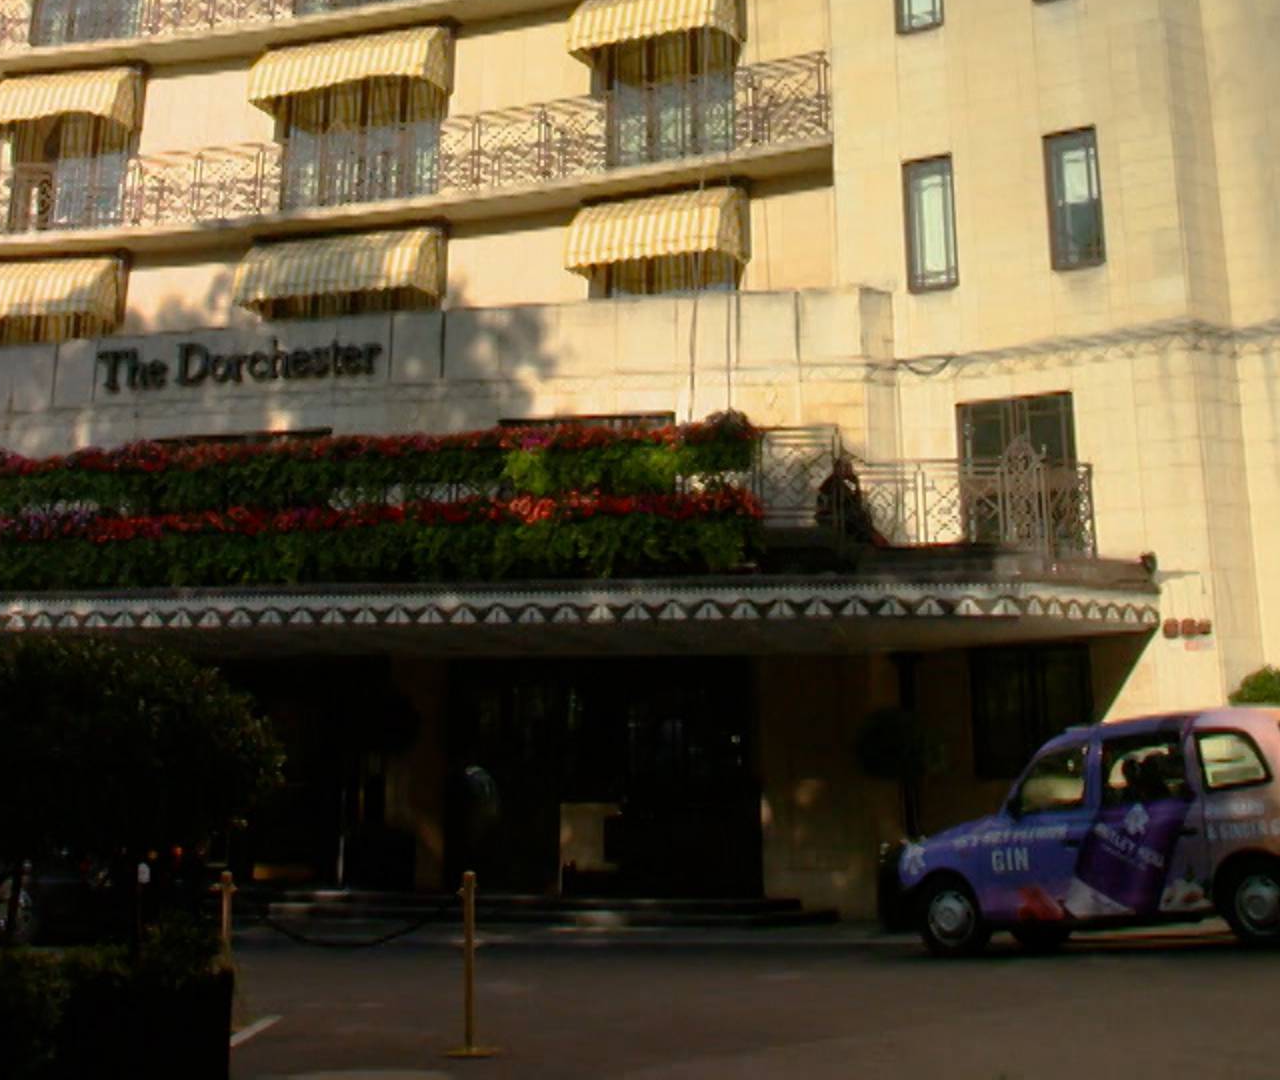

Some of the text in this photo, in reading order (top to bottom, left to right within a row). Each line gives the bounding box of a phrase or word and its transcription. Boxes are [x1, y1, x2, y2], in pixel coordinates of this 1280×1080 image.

[97, 336, 382, 393] The Dorchester
[991, 847, 1030, 874] GIN
